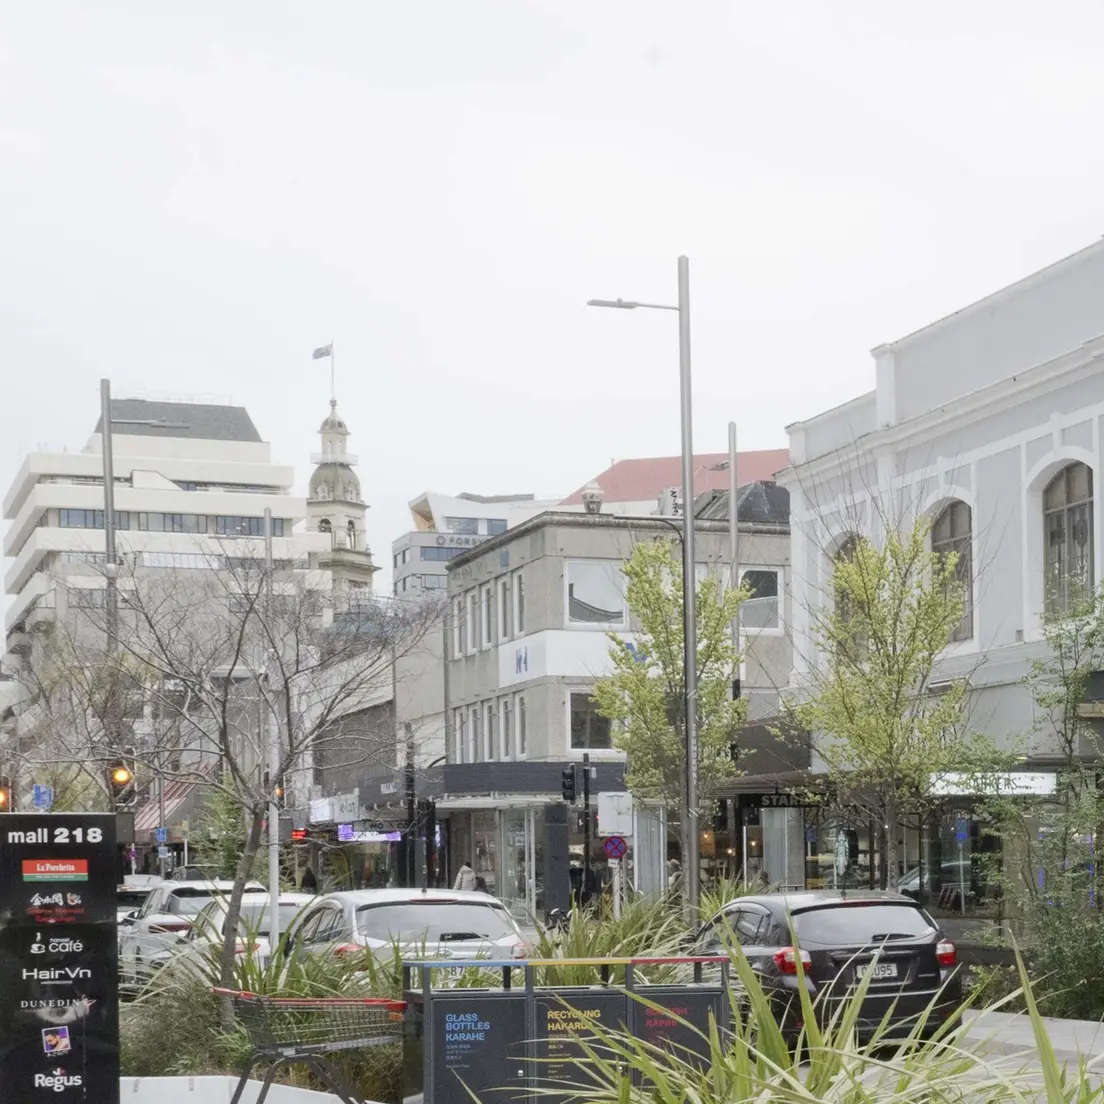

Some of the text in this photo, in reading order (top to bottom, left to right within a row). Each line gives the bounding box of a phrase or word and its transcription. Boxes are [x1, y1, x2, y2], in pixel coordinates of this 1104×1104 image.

[8, 827, 103, 844] mall 218
[48, 940, 84, 953] café
[22, 967, 92, 980] HairVn
[20, 999, 80, 1009] DUNEDIN
[446, 1013, 478, 1022] GLASS
[547, 1010, 601, 1019] RECYCING
[446, 1022, 490, 1031] BOTTLES
[547, 1022, 592, 1031] HAKARU
[446, 1032, 485, 1041] KARAHE
[34, 1073, 83, 1092] Regus
